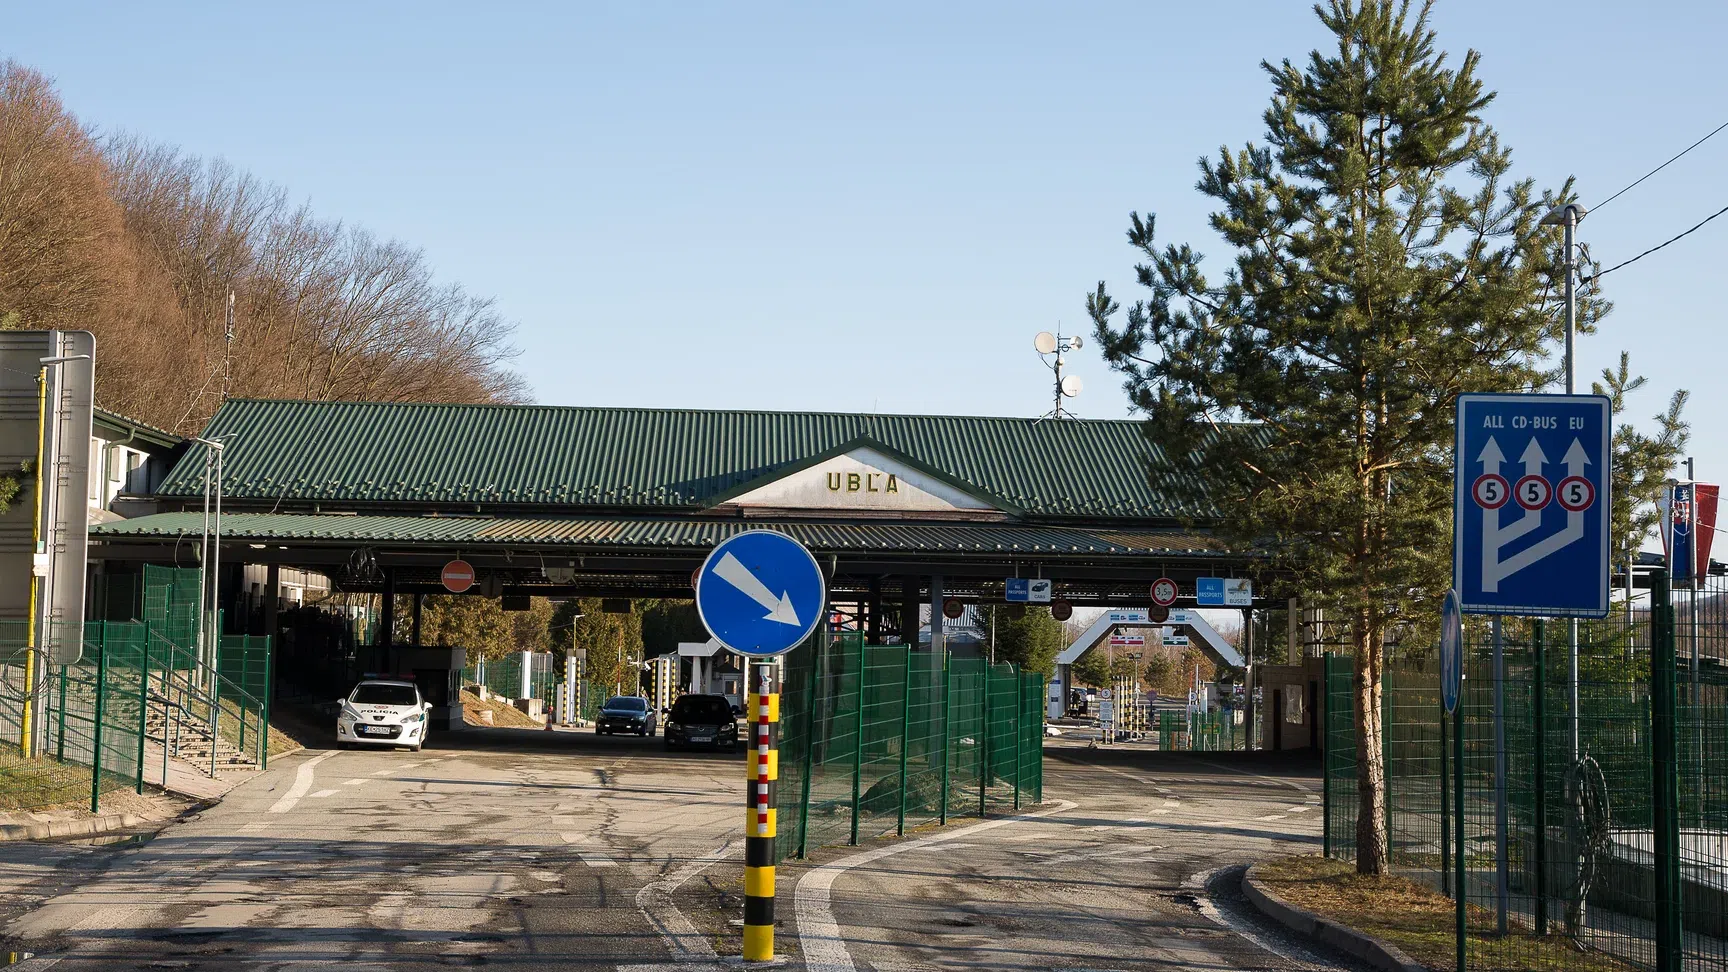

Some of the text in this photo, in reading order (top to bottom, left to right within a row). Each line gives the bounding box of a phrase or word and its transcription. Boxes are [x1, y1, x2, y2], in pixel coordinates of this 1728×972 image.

[1483, 415, 1584, 430] ALL CD-BUS EU
[1485, 482, 1582, 504] 5 5 5
